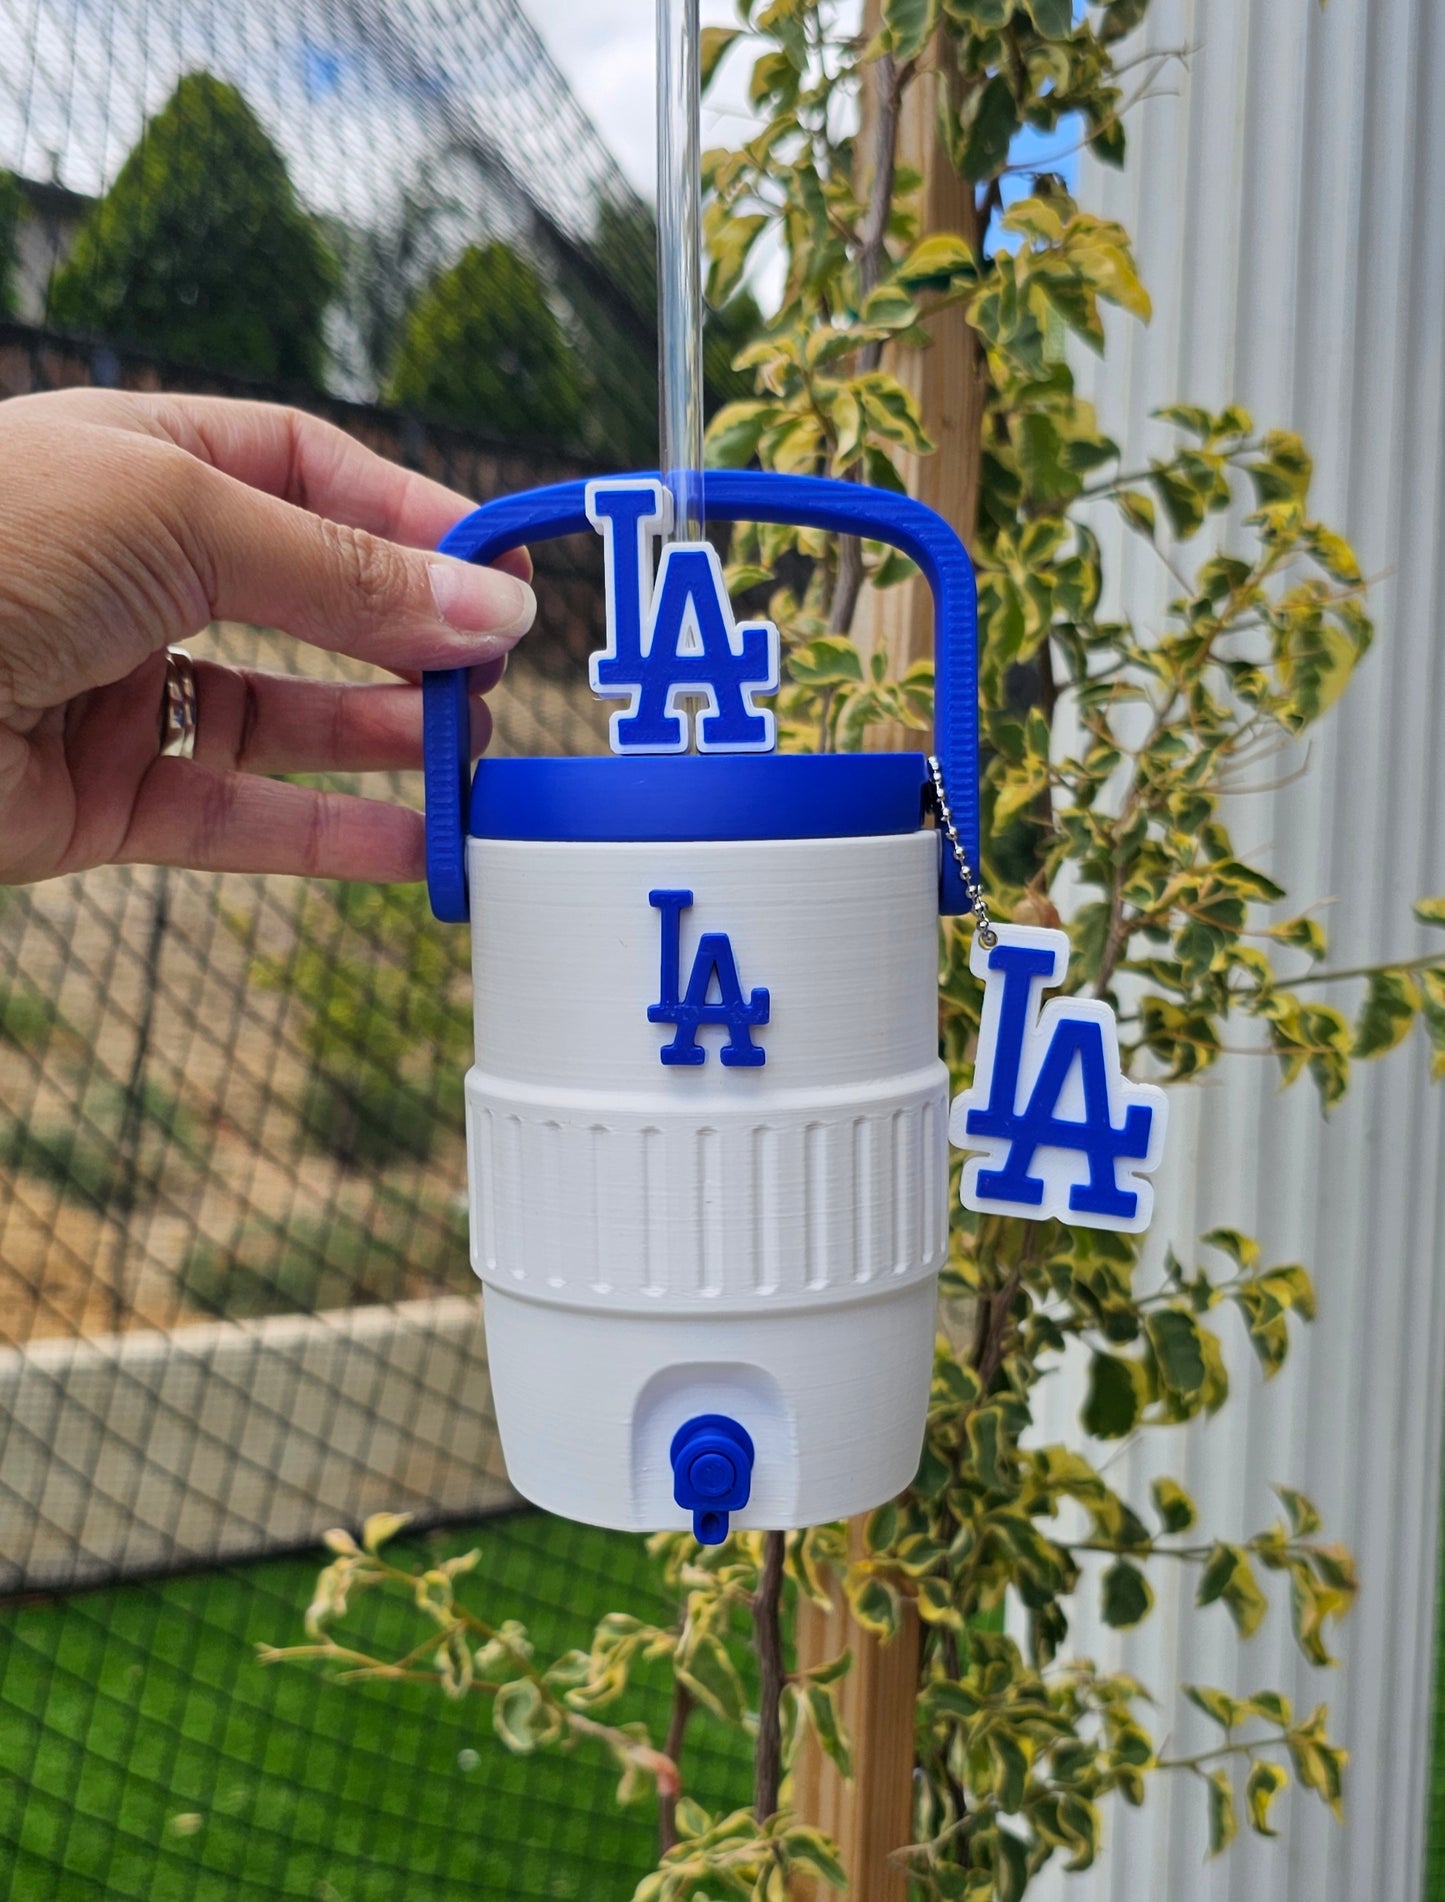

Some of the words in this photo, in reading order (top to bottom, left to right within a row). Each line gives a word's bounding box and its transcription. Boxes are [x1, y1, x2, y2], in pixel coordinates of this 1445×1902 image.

[594, 488, 770, 746] LA
[646, 889, 771, 1067] LA
[965, 944, 1153, 1219] LA
